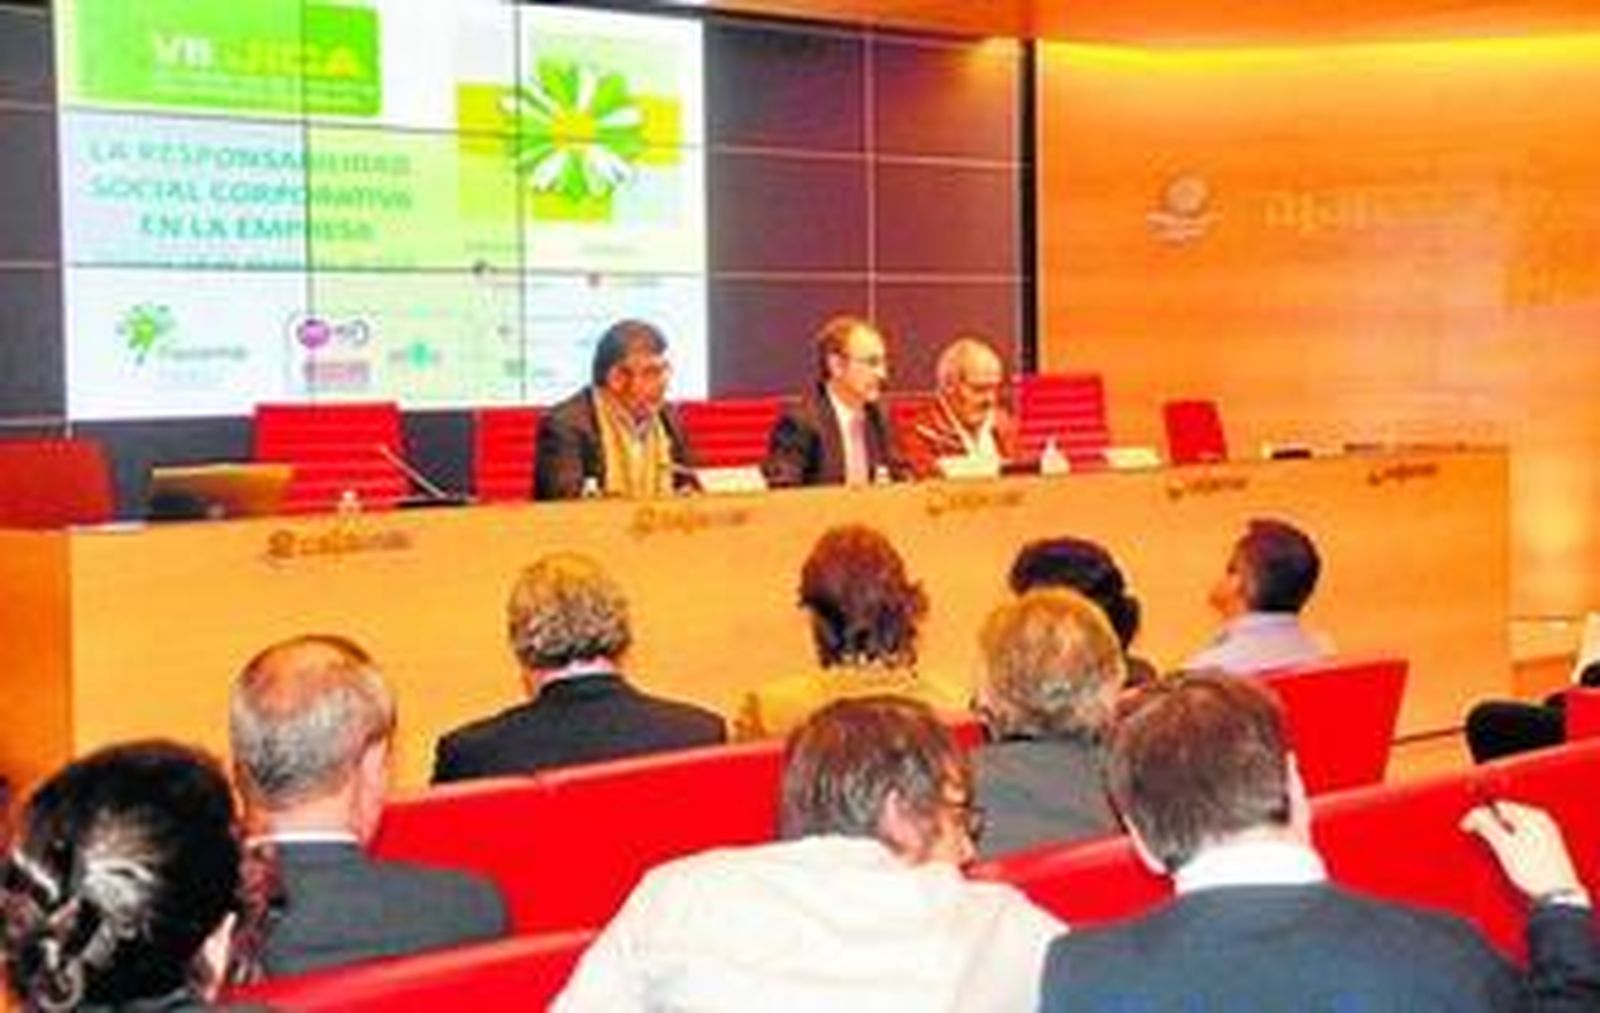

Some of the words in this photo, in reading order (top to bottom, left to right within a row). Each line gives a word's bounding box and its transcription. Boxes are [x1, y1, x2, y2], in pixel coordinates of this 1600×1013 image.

[90, 141, 129, 164] LA
[138, 142, 413, 176] RESPONSABILIDAD
[88, 176, 202, 203] SOCIAL
[208, 179, 413, 211] CORPORATIVA
[140, 212, 181, 238] EN
[190, 214, 227, 240] LA
[236, 216, 376, 243] EMPRESA
